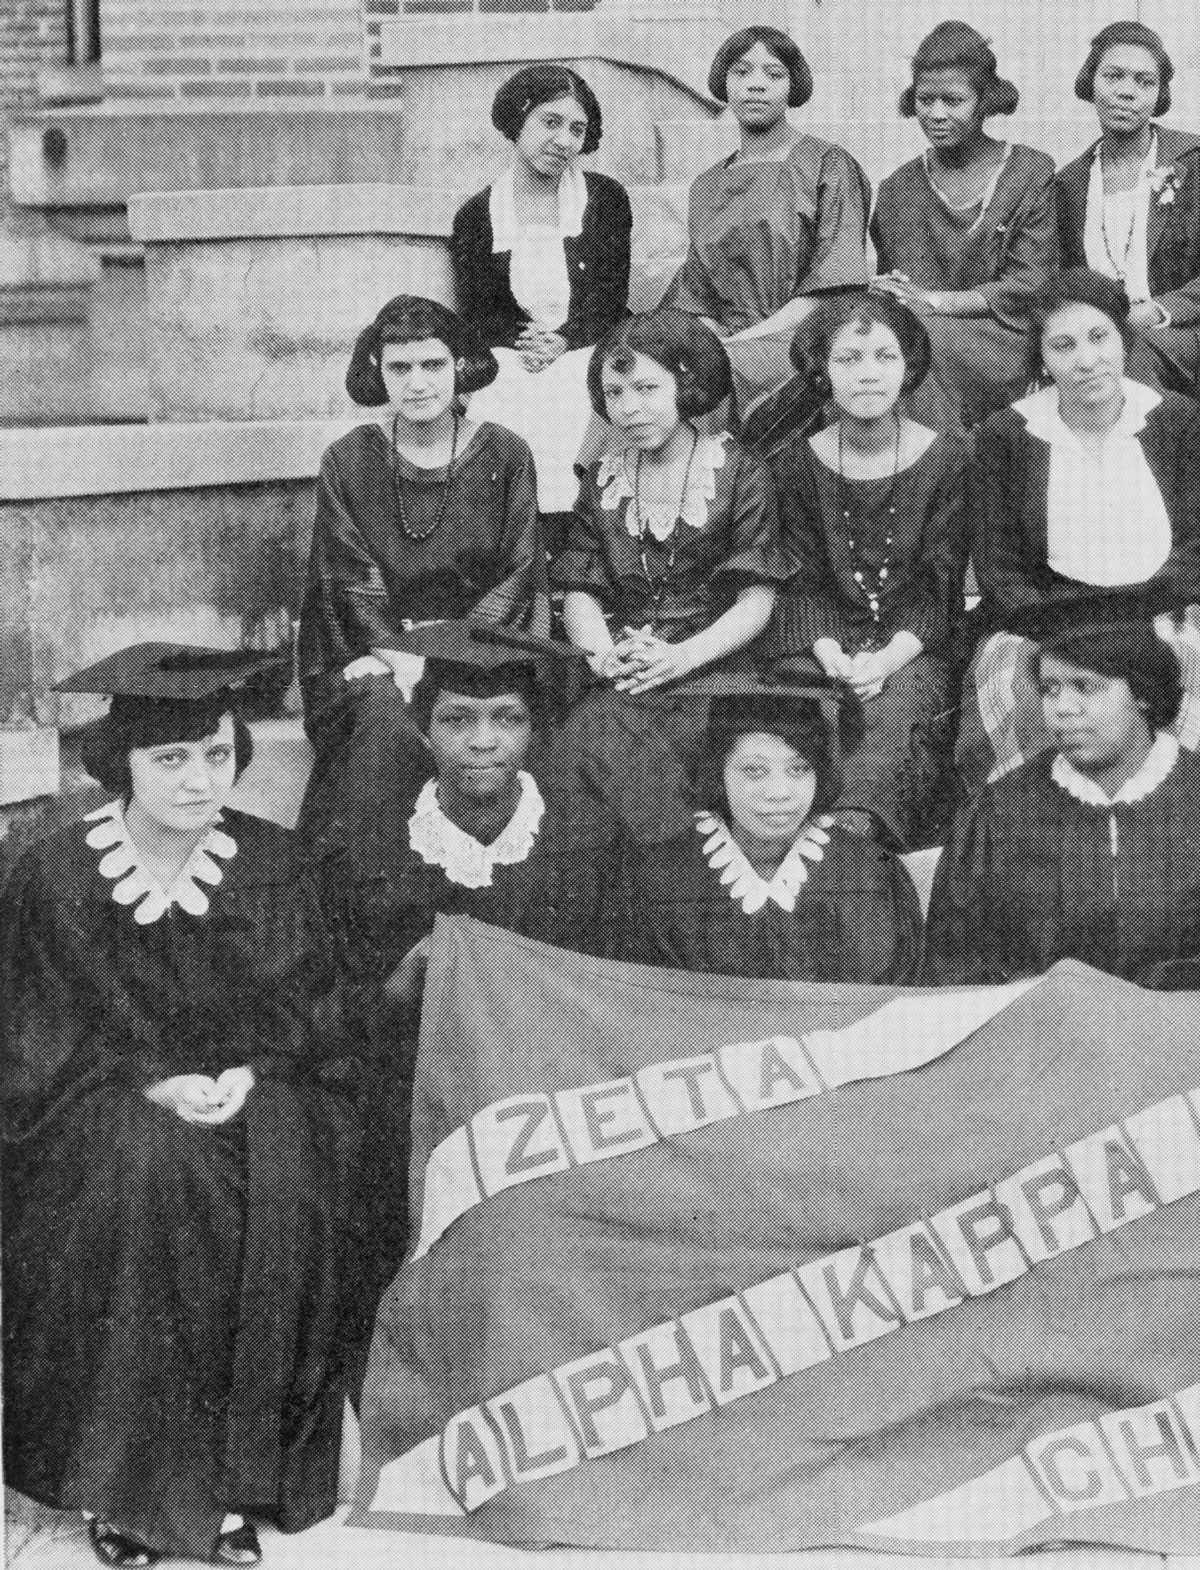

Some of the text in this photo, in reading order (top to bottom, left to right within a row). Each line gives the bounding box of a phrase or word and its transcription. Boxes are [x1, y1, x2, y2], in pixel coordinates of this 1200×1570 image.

[495, 1043, 809, 1176] ZETA
[456, 1307, 769, 1501] ALPHA
[821, 1138, 1156, 1340] KAPPA
